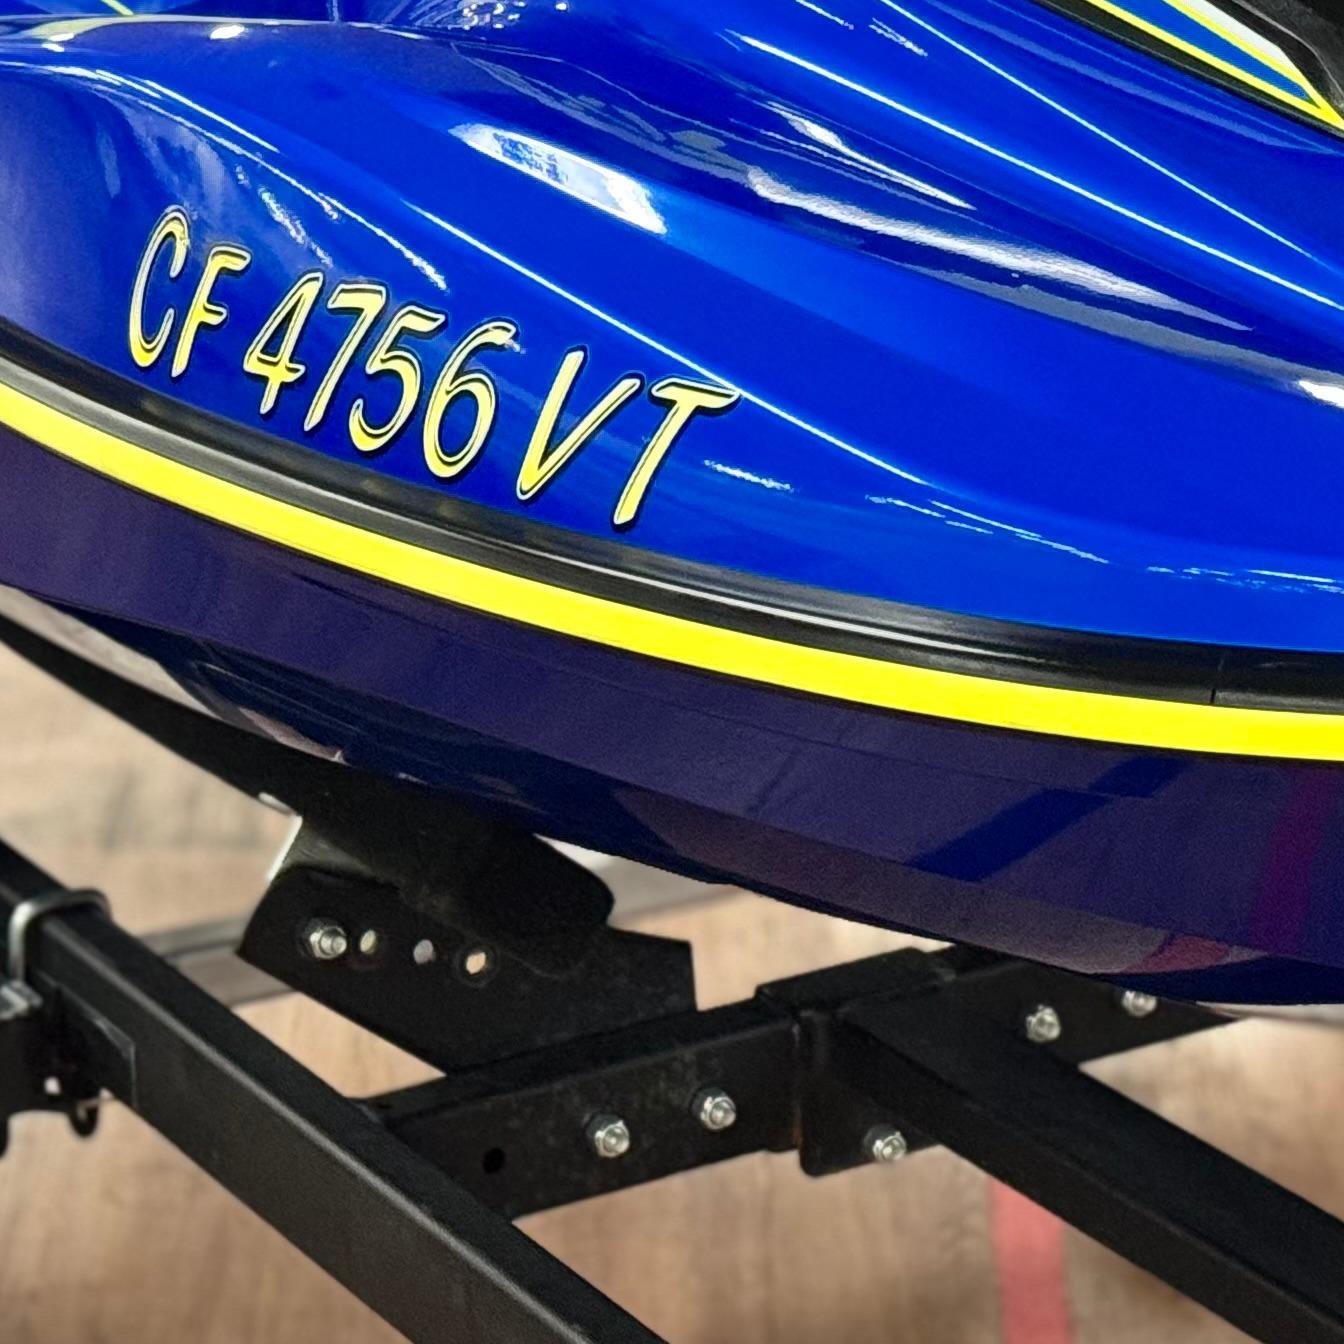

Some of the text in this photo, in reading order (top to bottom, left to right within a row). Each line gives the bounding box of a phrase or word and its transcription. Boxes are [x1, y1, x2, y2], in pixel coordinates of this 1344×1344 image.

[128, 205, 741, 525] CF 4756 VT
